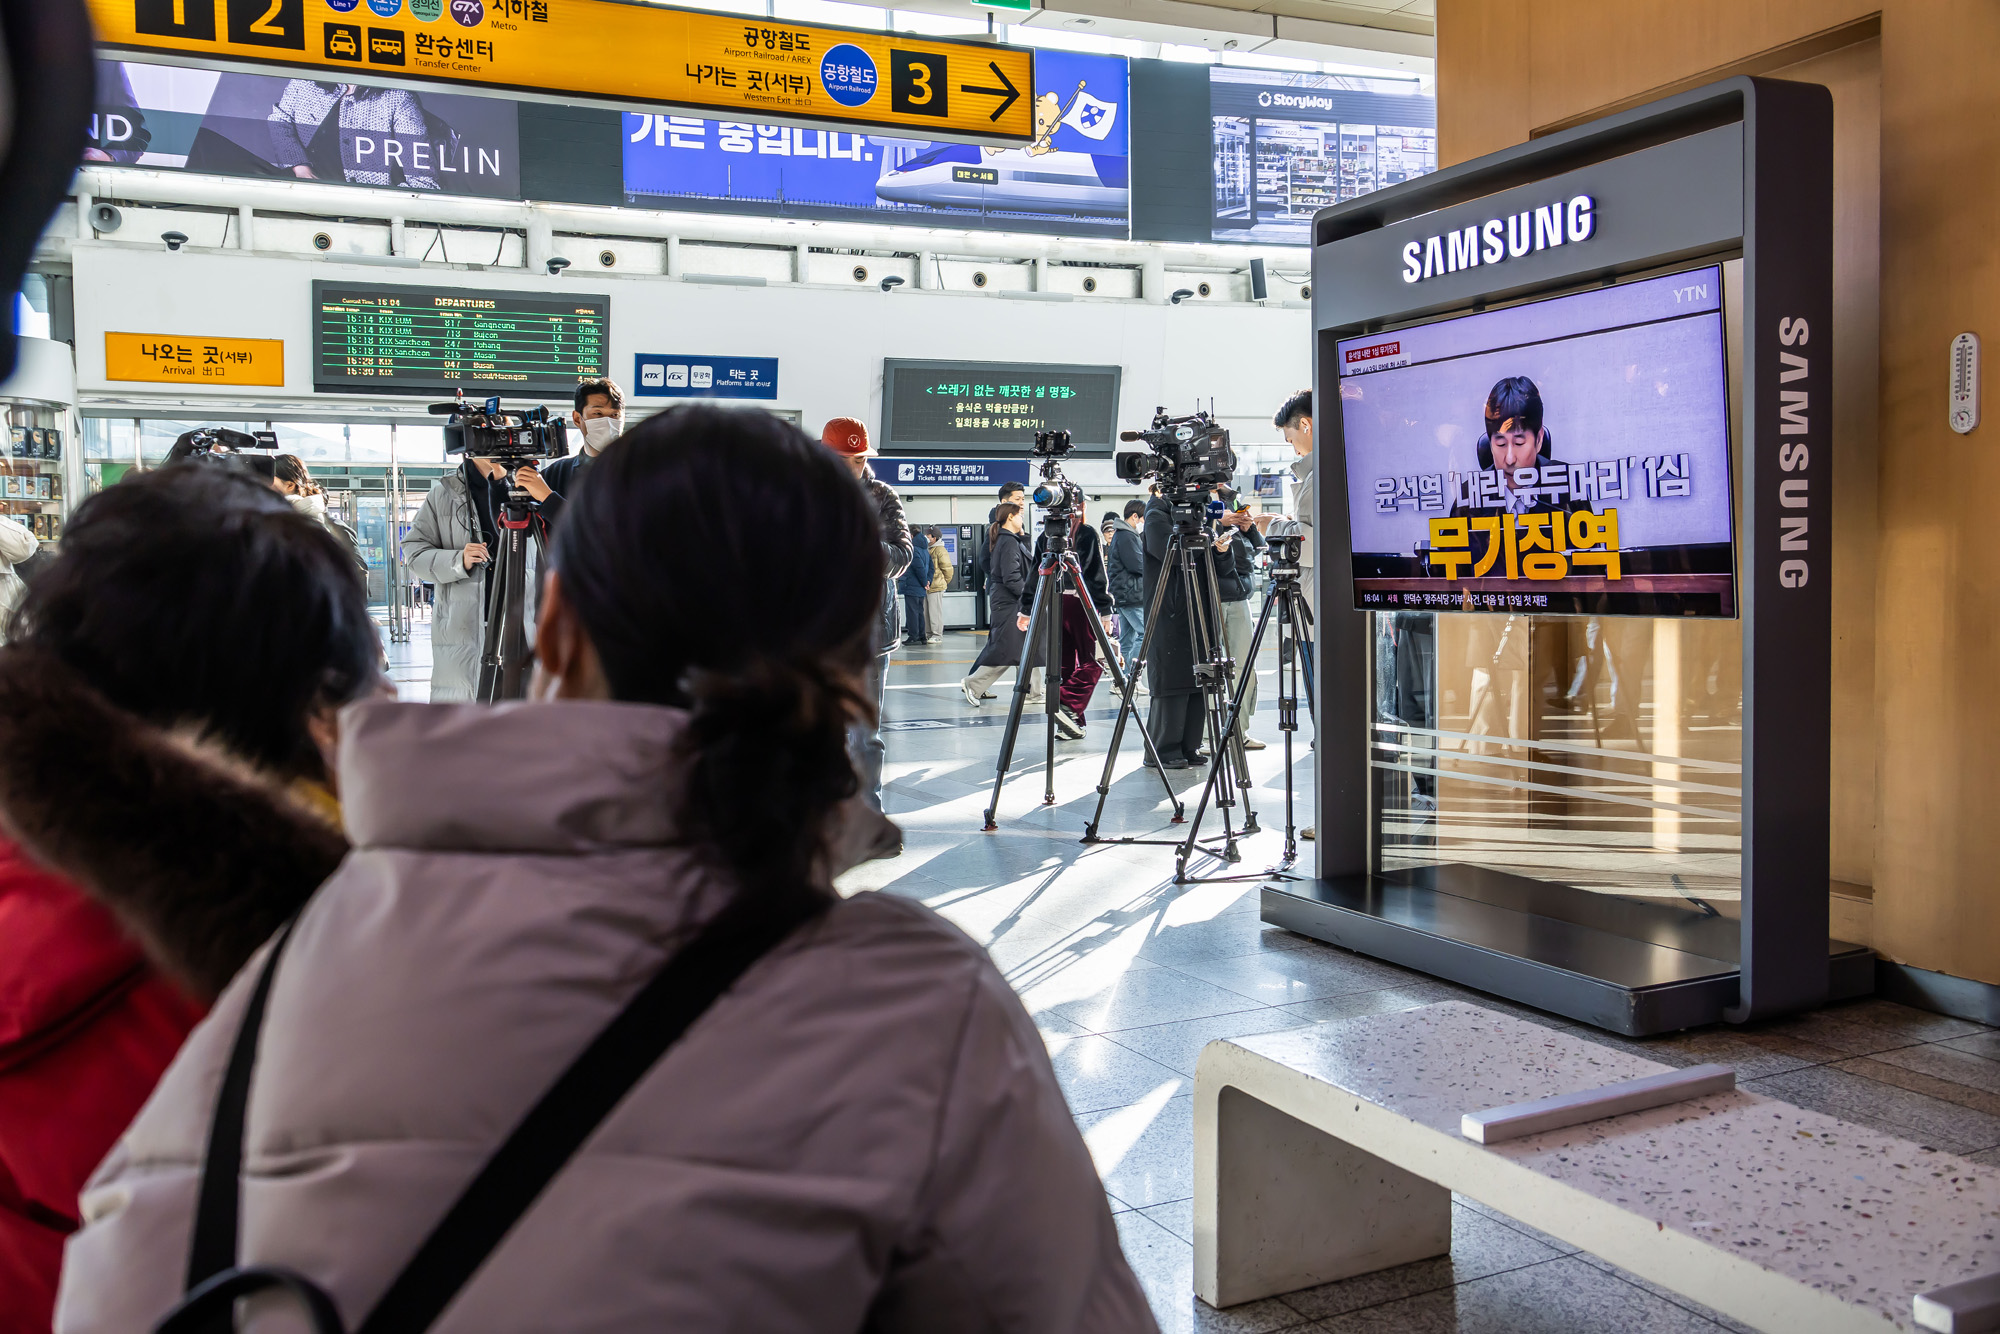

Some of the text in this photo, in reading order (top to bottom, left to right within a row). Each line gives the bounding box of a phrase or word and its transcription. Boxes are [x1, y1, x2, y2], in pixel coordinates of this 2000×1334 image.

[452, 1, 480, 13] GTX
[463, 14, 471, 24] A
[491, 20, 518, 31] Metro
[744, 27, 810, 51] 공항철도
[415, 32, 494, 62] 환승센터
[724, 48, 752, 59] Airport
[754, 51, 785, 62] Railroad
[791, 55, 812, 64] AREX
[414, 58, 482, 73] Transfer Center
[686, 63, 811, 95] 나가는 곳(서부)
[823, 63, 875, 84] 공항철도
[828, 83, 872, 94] Airport Railroad
[907, 62, 933, 105] 3
[744, 93, 812, 106] Western Exit 出口
[355, 136, 500, 176] PRELIN
[1402, 194, 1597, 284] SAMSUNG
[1673, 283, 1707, 303] YTN
[434, 298, 496, 309] DEPARTURES
[142, 343, 252, 364] 나오는 곳(서부)
[162, 365, 225, 377] Arrival 出口
[729, 369, 758, 380] 타는 곳
[716, 379, 742, 387] Platforms
[937, 384, 969, 397] 쓰레기
[974, 384, 996, 397] 없는
[999, 385, 1031, 398] 깨끗한
[1035, 385, 1045, 398] 설
[956, 402, 982, 413] 음식은
[992, 418, 1010, 429] 사용
[1013, 419, 1038, 429] 줄이기
[1779, 316, 1810, 588] SAMSUNG
[918, 464, 984, 475] 승차권 자동발매기
[1374, 453, 1692, 513] 윤석열 '내란 우두머리' 1심
[1428, 508, 1622, 581] 무기징역
[1364, 594, 1380, 602] 16:04
[1403, 594, 1422, 604] 한덕수
[1482, 594, 1497, 606] 다음
[1497, 594, 1505, 606] 달
[1506, 595, 1523, 606] 13일
[1524, 595, 1532, 606] 첫
[1532, 595, 1548, 607] 재판
